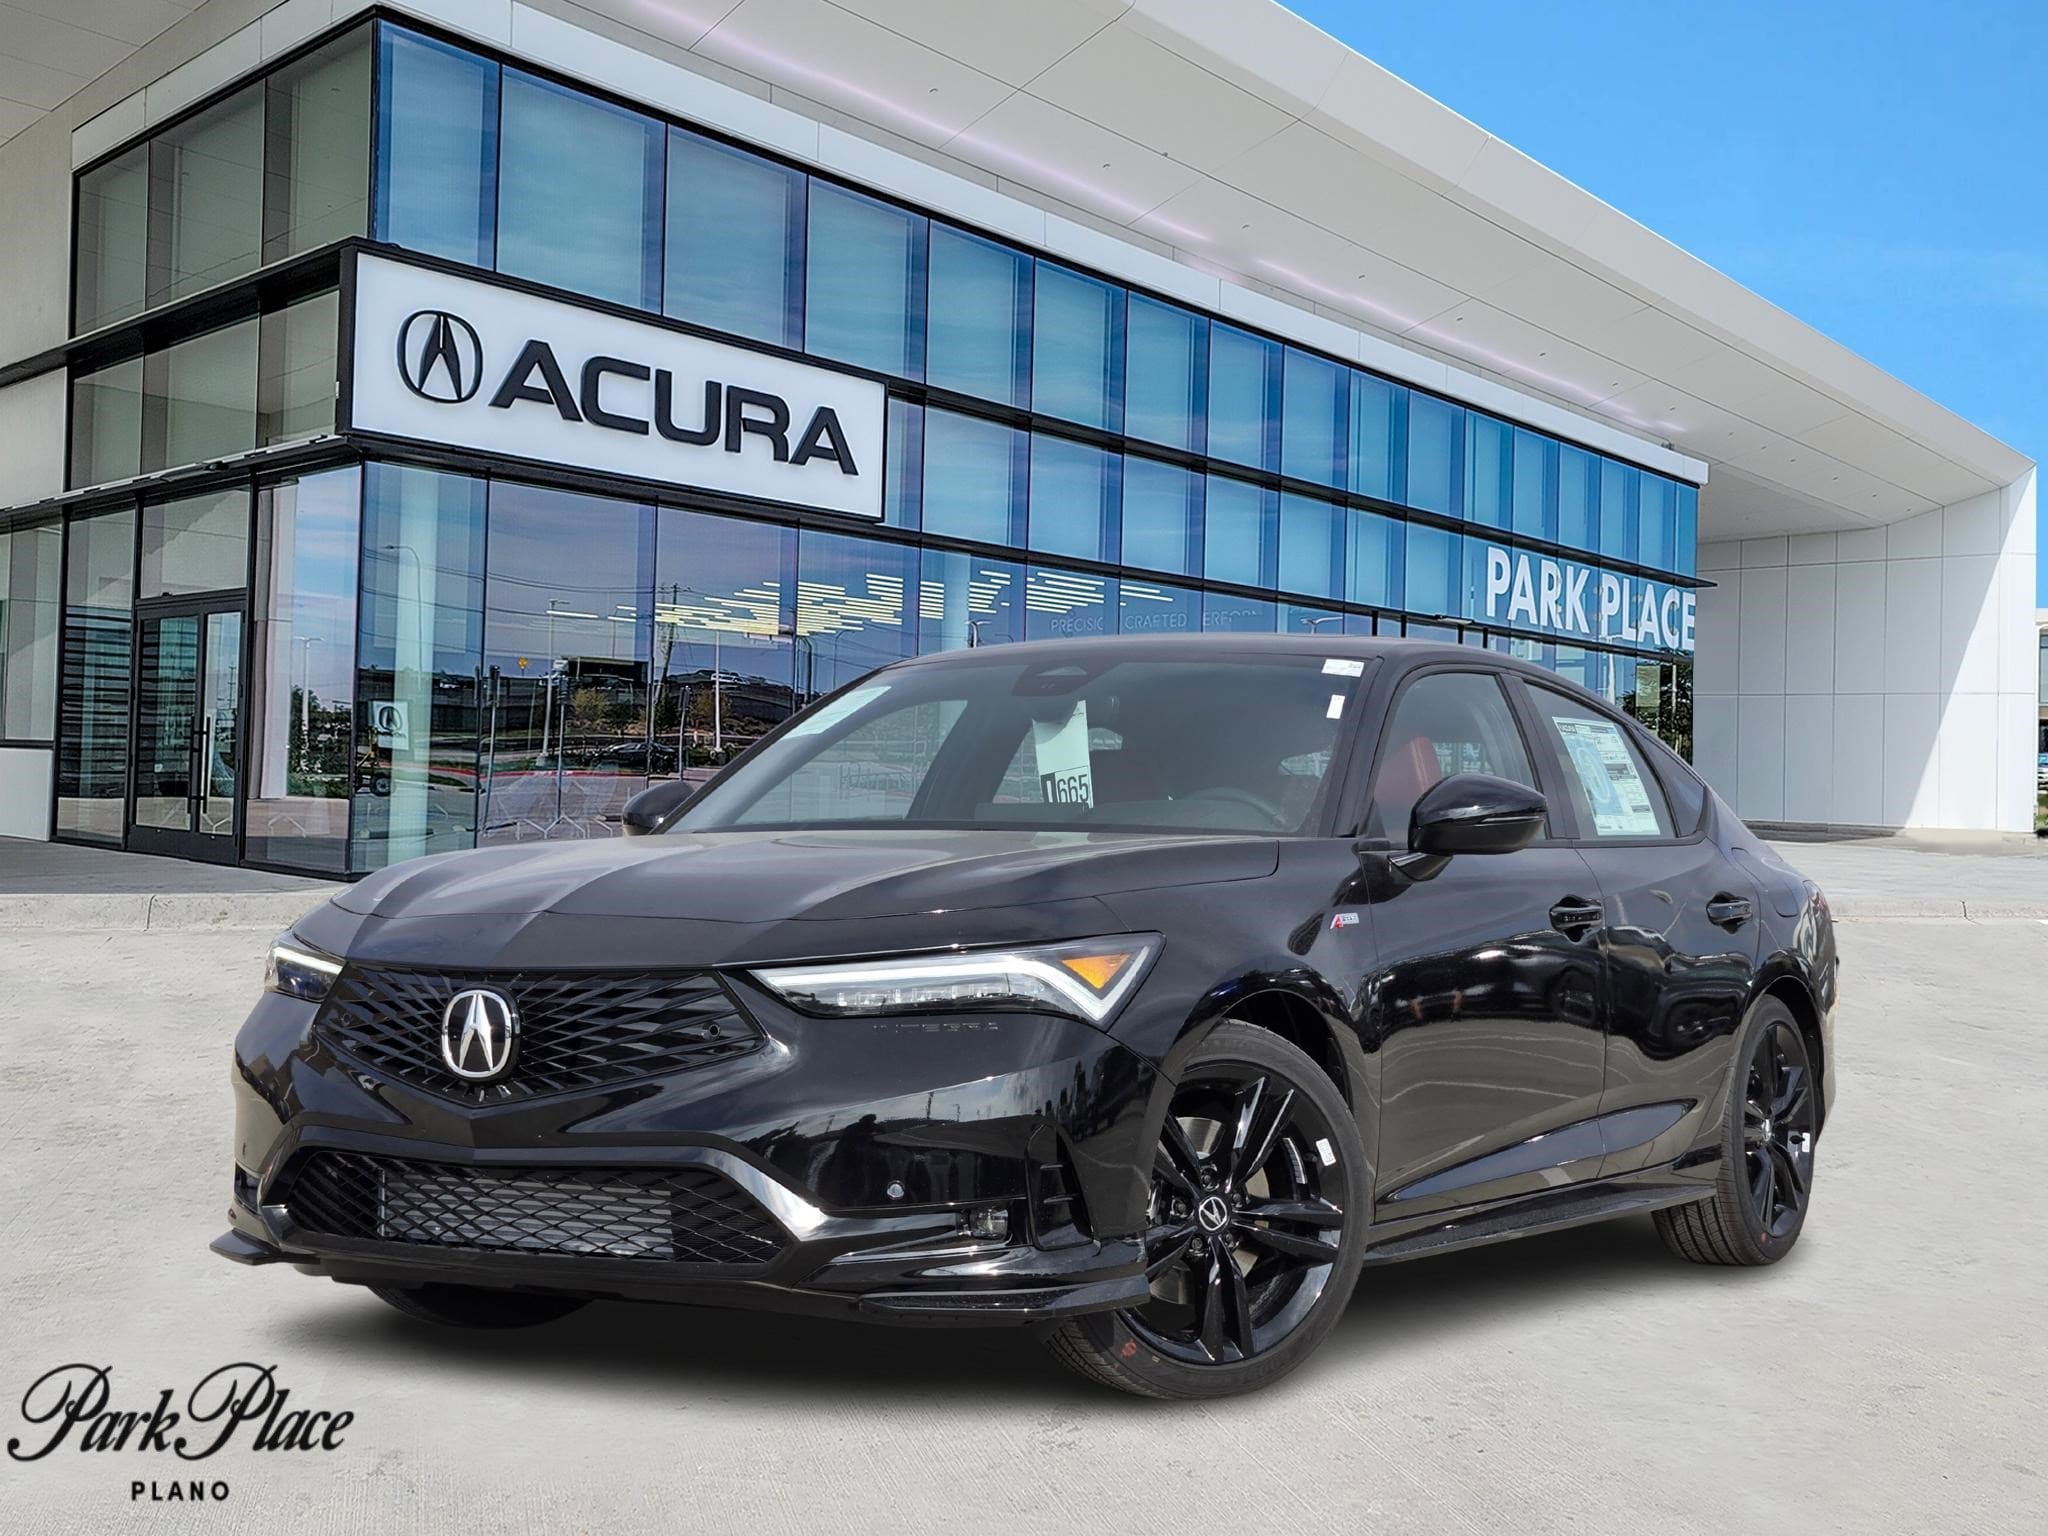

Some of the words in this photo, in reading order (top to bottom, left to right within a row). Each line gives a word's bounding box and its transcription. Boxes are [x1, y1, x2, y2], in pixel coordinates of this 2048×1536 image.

[489, 339, 859, 476] ACURA
[1124, 613, 1187, 630] CRAFTED
[1486, 546, 1590, 634] PARK
[1601, 573, 1697, 650] PLACE
